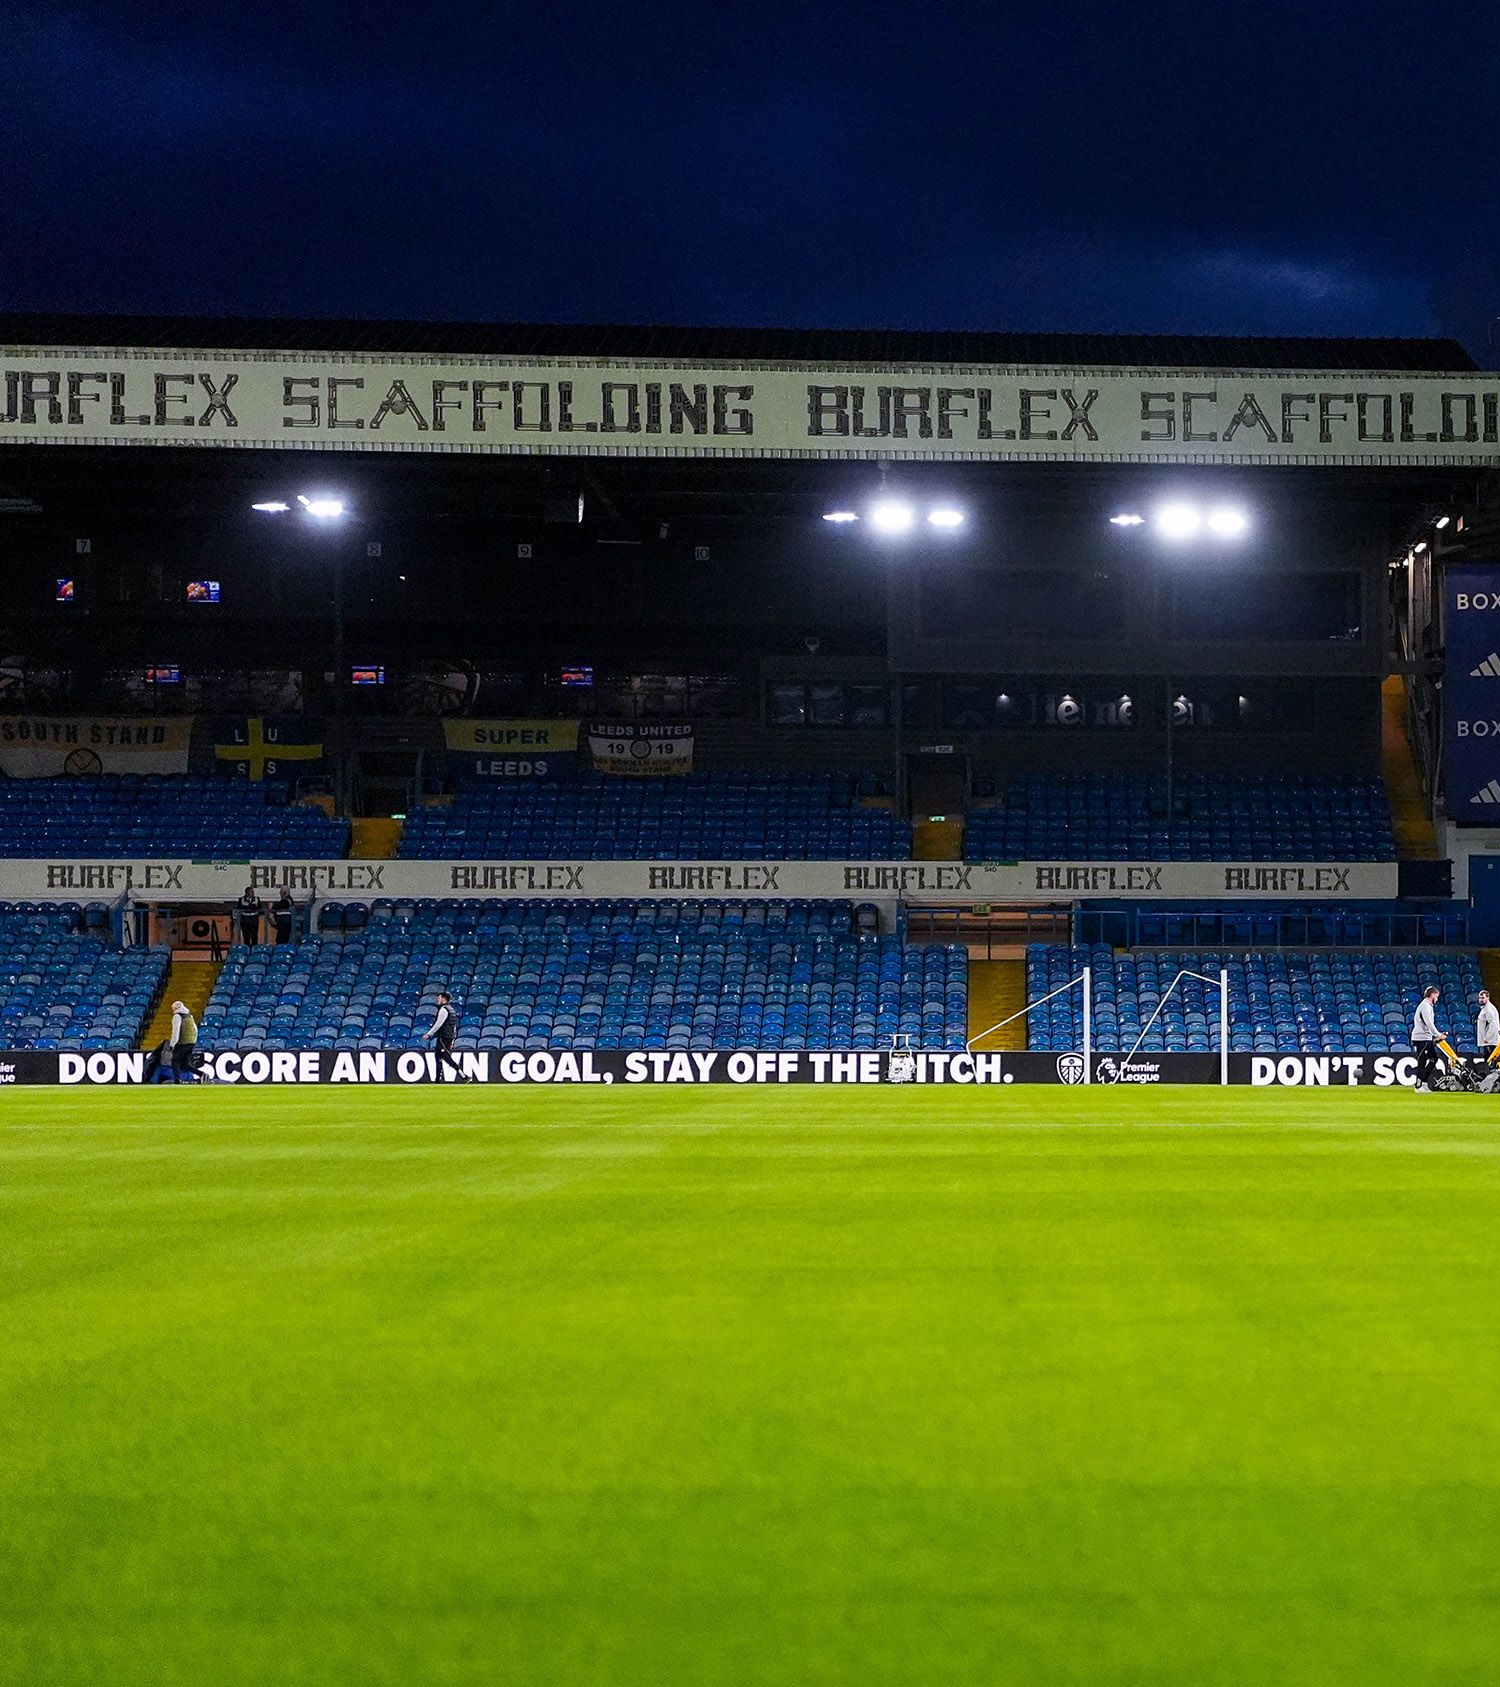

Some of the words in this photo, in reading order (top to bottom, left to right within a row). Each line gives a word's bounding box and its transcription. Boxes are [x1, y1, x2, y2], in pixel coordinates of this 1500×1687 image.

[283, 376, 753, 435] SCAFFOLDING
[807, 384, 1099, 442] BURFLEX
[2, 721, 78, 744] SOUTH
[474, 728, 549, 745] SUPER
[590, 723, 634, 736] LEEDS
[640, 725, 692, 736] UNITED
[608, 743, 625, 754] 19
[656, 743, 674, 754] 19
[476, 759, 548, 777] LEEDS
[47, 865, 182, 889] BURFLEX
[251, 865, 384, 889] BURFLEX
[450, 866, 583, 889] BURFLEX
[649, 866, 779, 890] BURFLEX
[843, 867, 972, 890] BURFLEX
[1036, 868, 1162, 891] BURFLEX
[1225, 868, 1350, 891] BURFLEX
[330, 1052, 386, 1083] AN
[500, 1051, 614, 1086] GOAL,
[625, 1052, 718, 1083] STAY
[727, 1052, 799, 1083] OFF
[808, 1052, 880, 1083] THE
[890, 1052, 1014, 1084] ITCH.
[1120, 1061, 1160, 1074] Premier
[1120, 1072, 1160, 1083] League
[1251, 1056, 1363, 1086] DON'T
